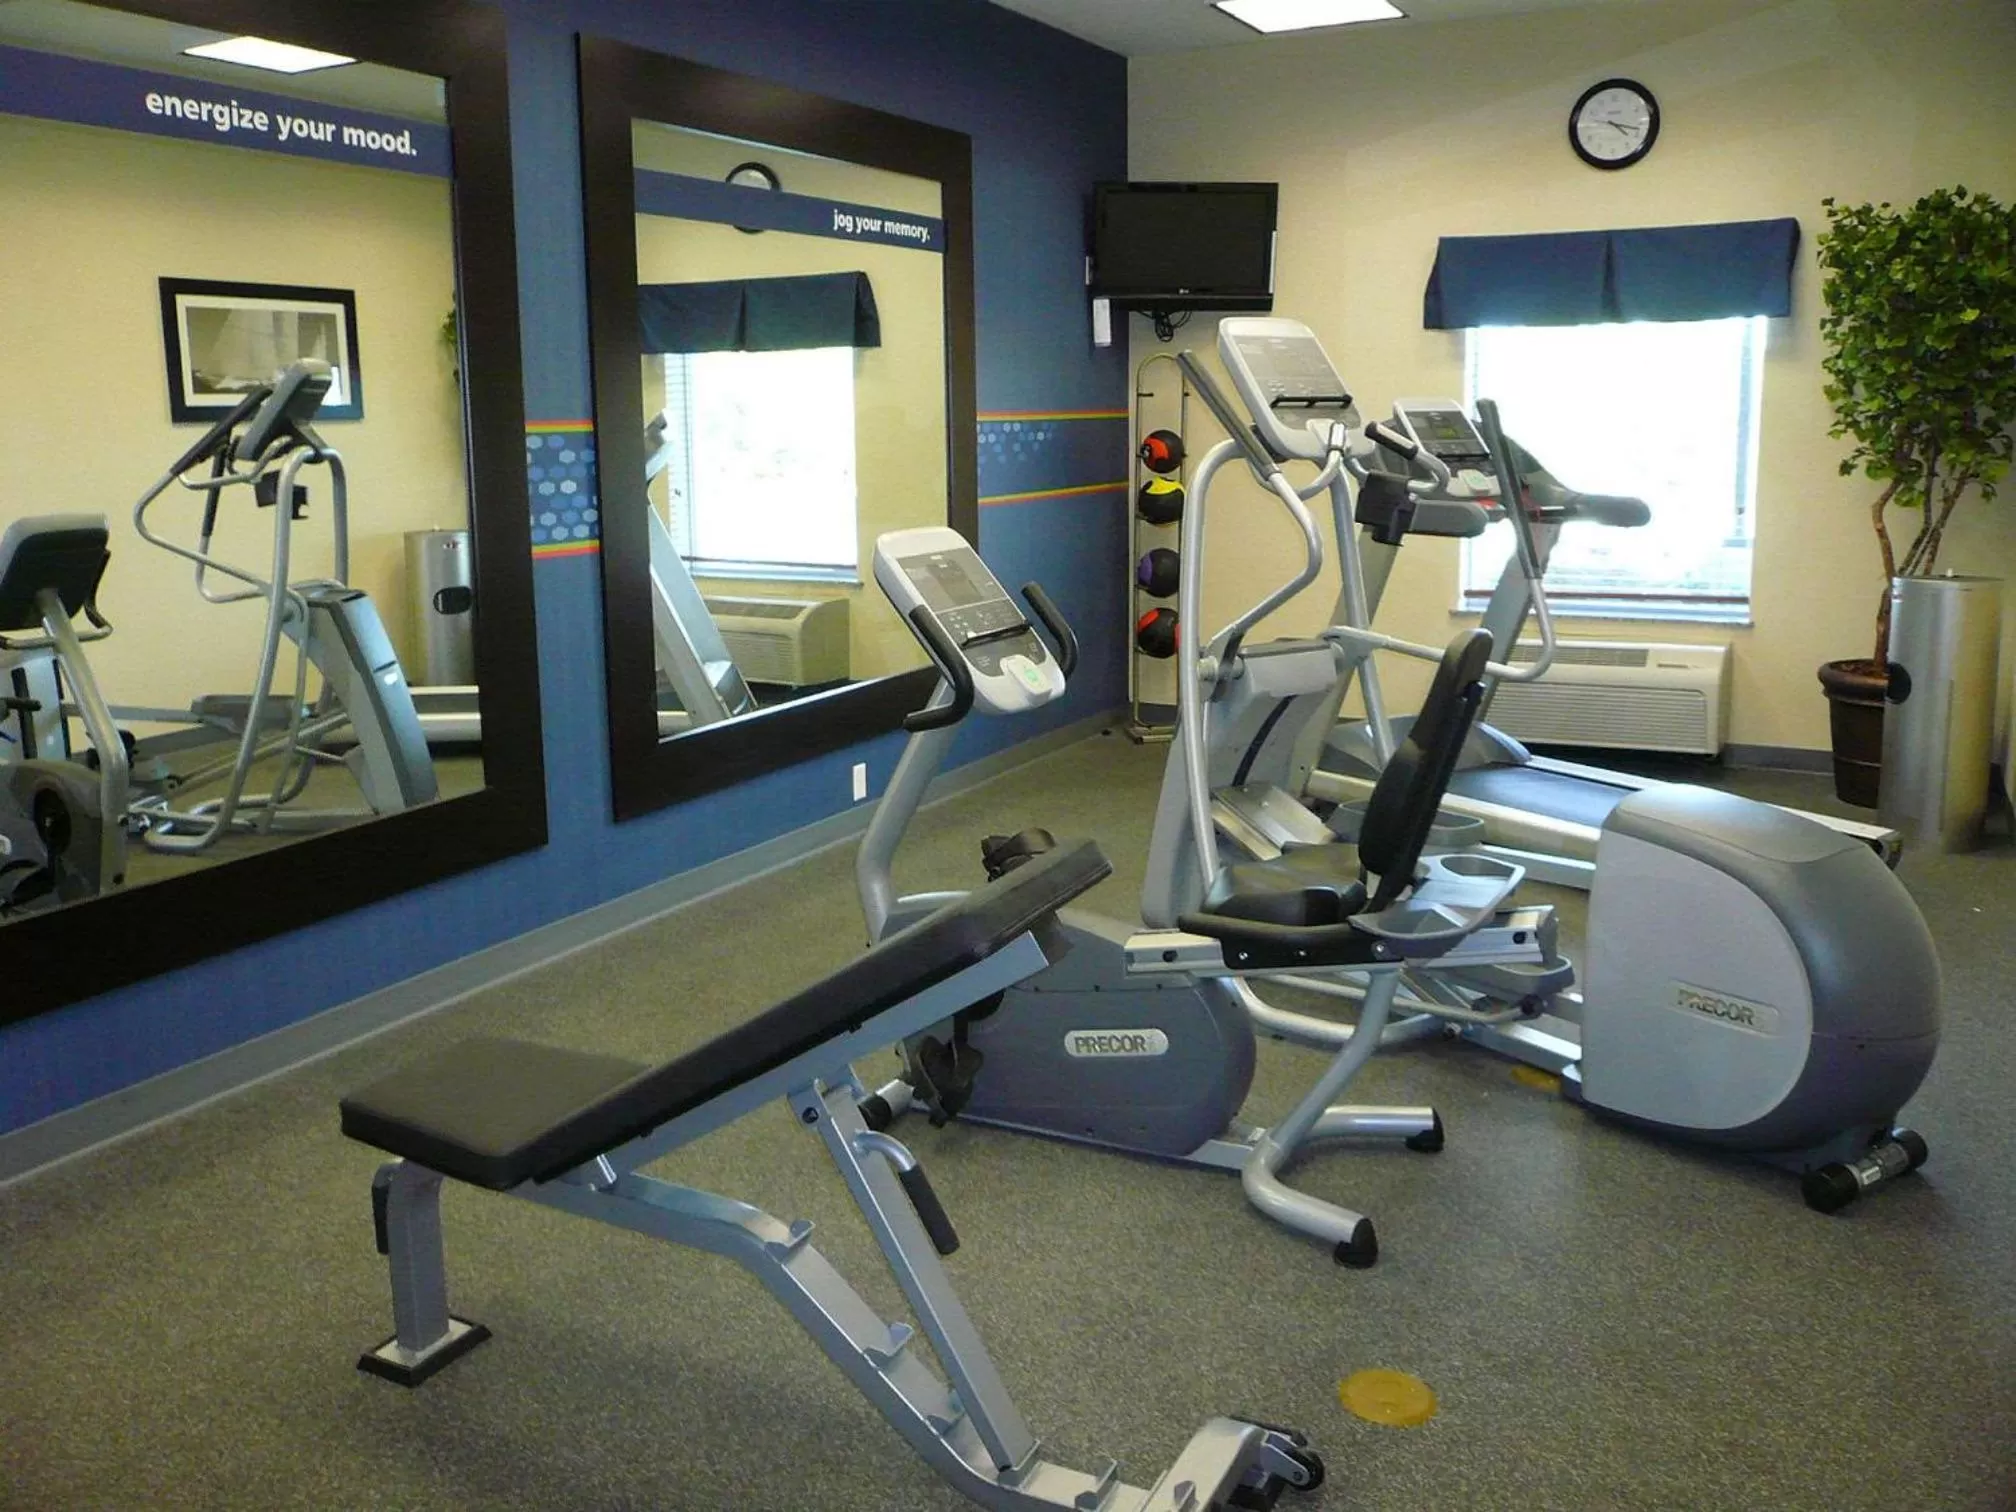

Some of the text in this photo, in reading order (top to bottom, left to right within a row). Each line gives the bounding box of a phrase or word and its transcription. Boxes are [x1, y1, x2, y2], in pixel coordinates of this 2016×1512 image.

[144, 91, 417, 156] energize your mood.
[833, 208, 931, 243] jog your memory.
[1678, 988, 1754, 1026] PRECOR
[1074, 1034, 1146, 1054] PRECOR
